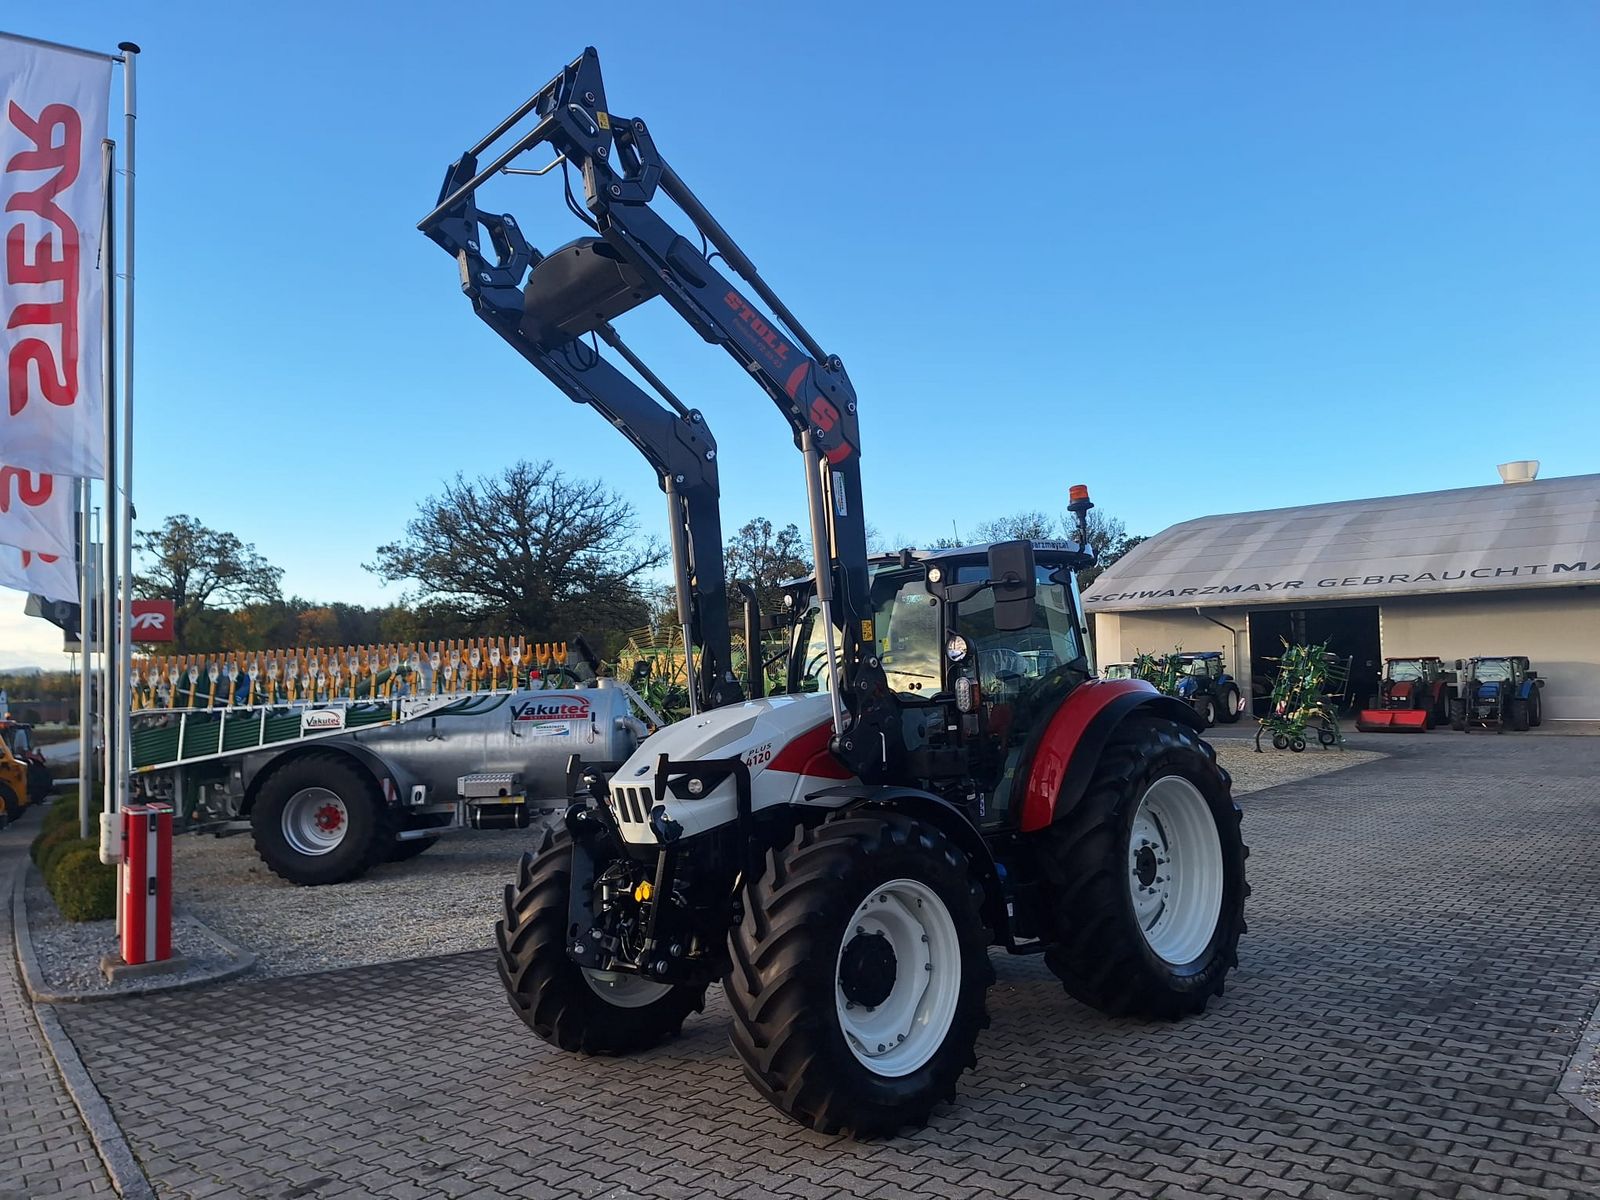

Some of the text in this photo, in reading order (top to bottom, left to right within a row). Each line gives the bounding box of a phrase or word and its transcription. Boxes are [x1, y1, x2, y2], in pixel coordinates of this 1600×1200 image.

[724, 291, 790, 361] STOLL
[1085, 580, 1305, 603] SCHWARZMAYR
[510, 701, 590, 721] Vakutec
[306, 716, 340, 727] Vakutec
[746, 750, 771, 768] 4120
[748, 743, 772, 756] PLUS
